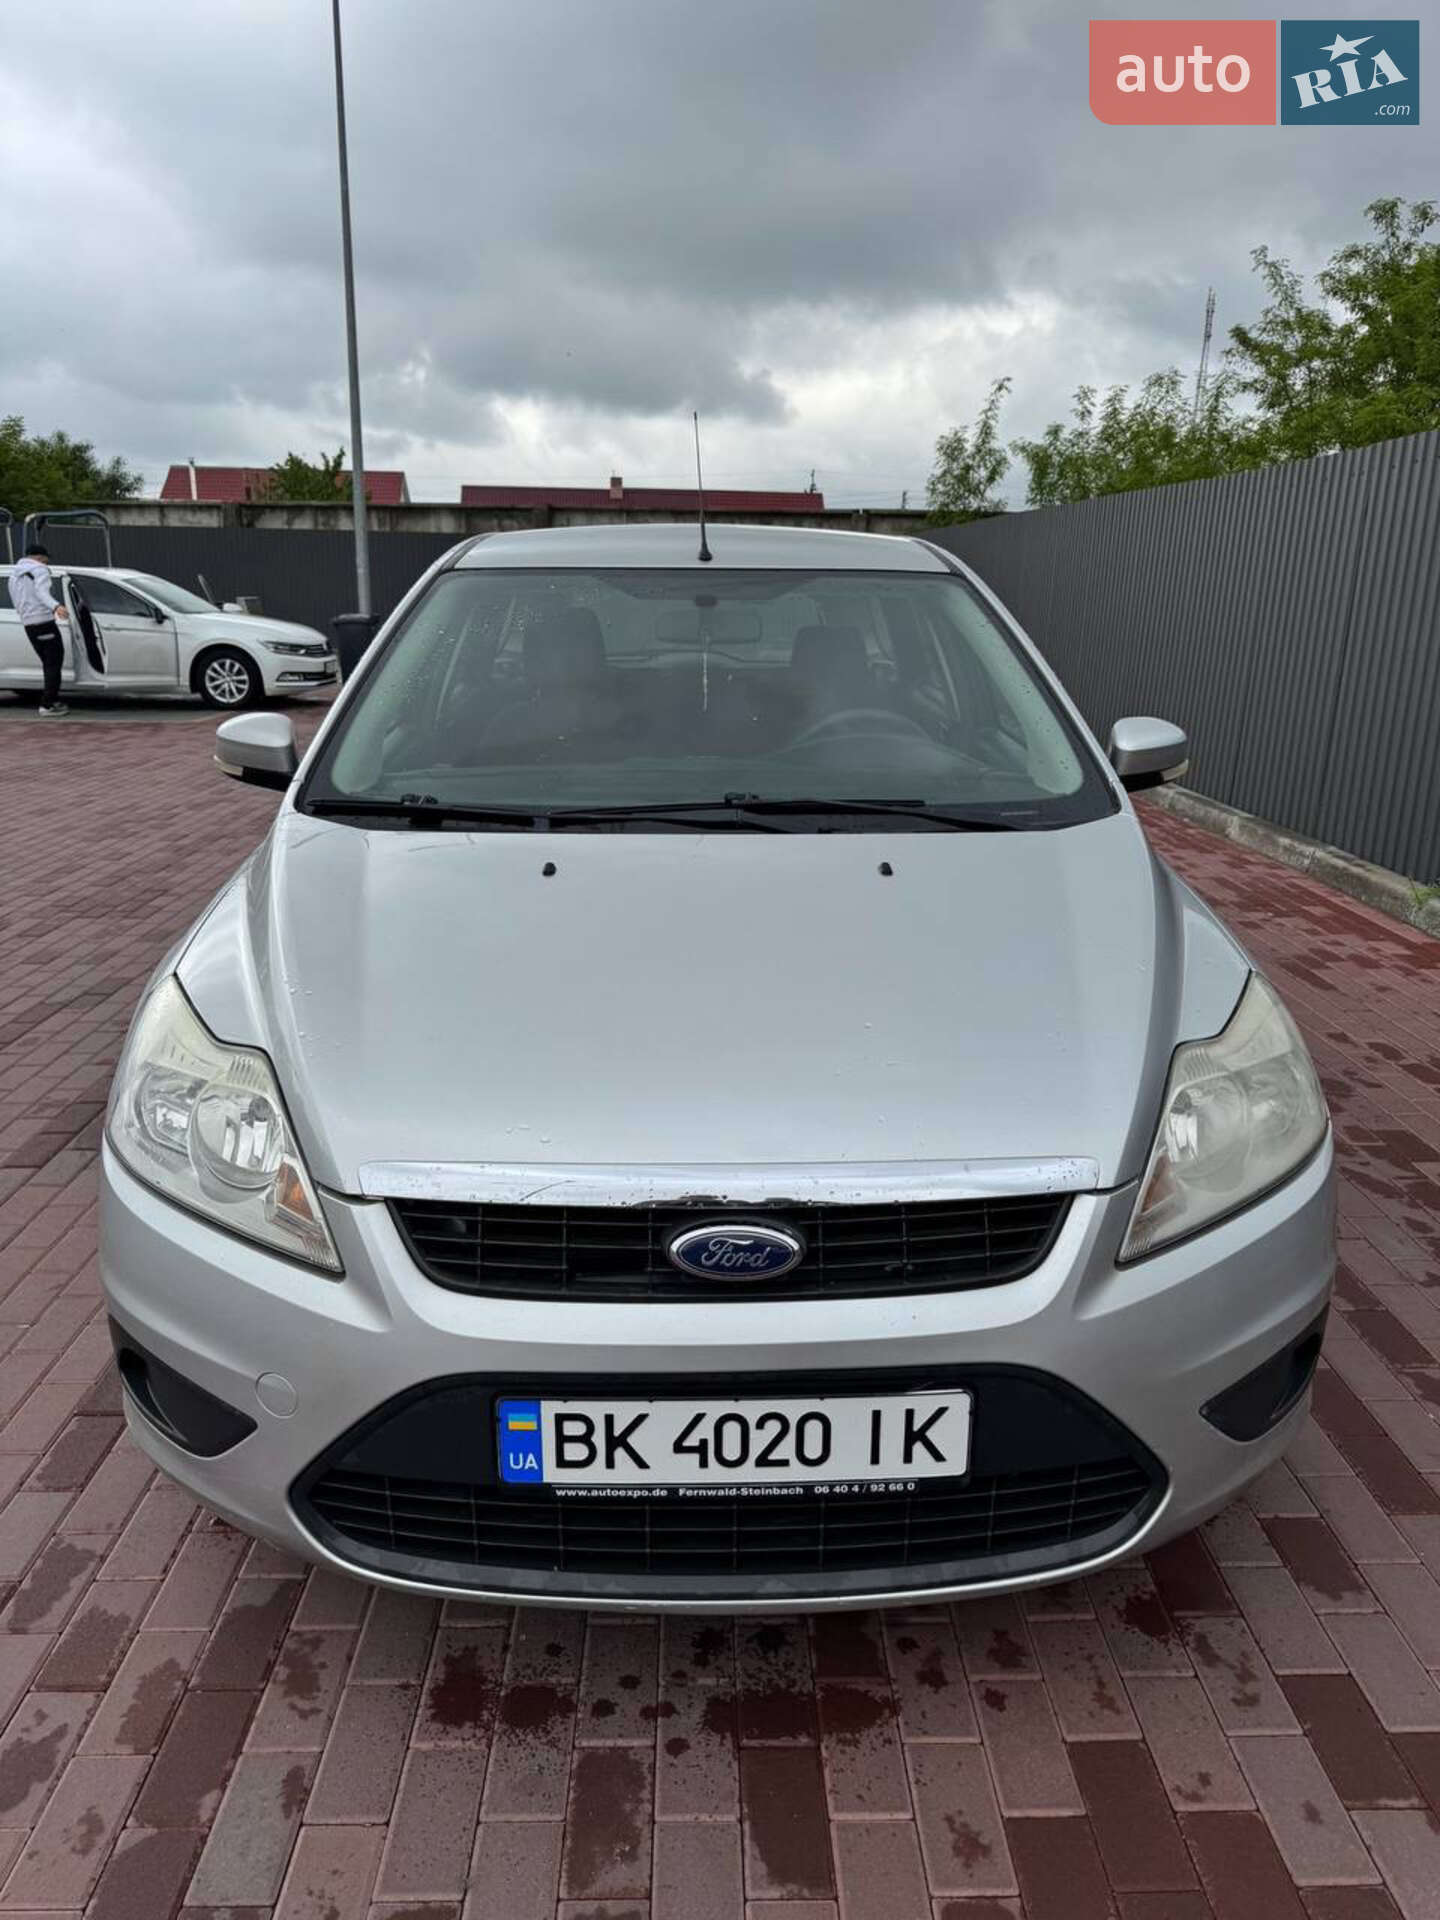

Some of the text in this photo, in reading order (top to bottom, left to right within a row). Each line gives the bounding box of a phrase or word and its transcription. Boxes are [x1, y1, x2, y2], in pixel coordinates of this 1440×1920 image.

[701, 1236, 770, 1267] Ford
[553, 1406, 950, 1470] BK 4020 IK
[509, 1452, 539, 1471] UA
[555, 1487, 668, 1499] www.autoexpo.de
